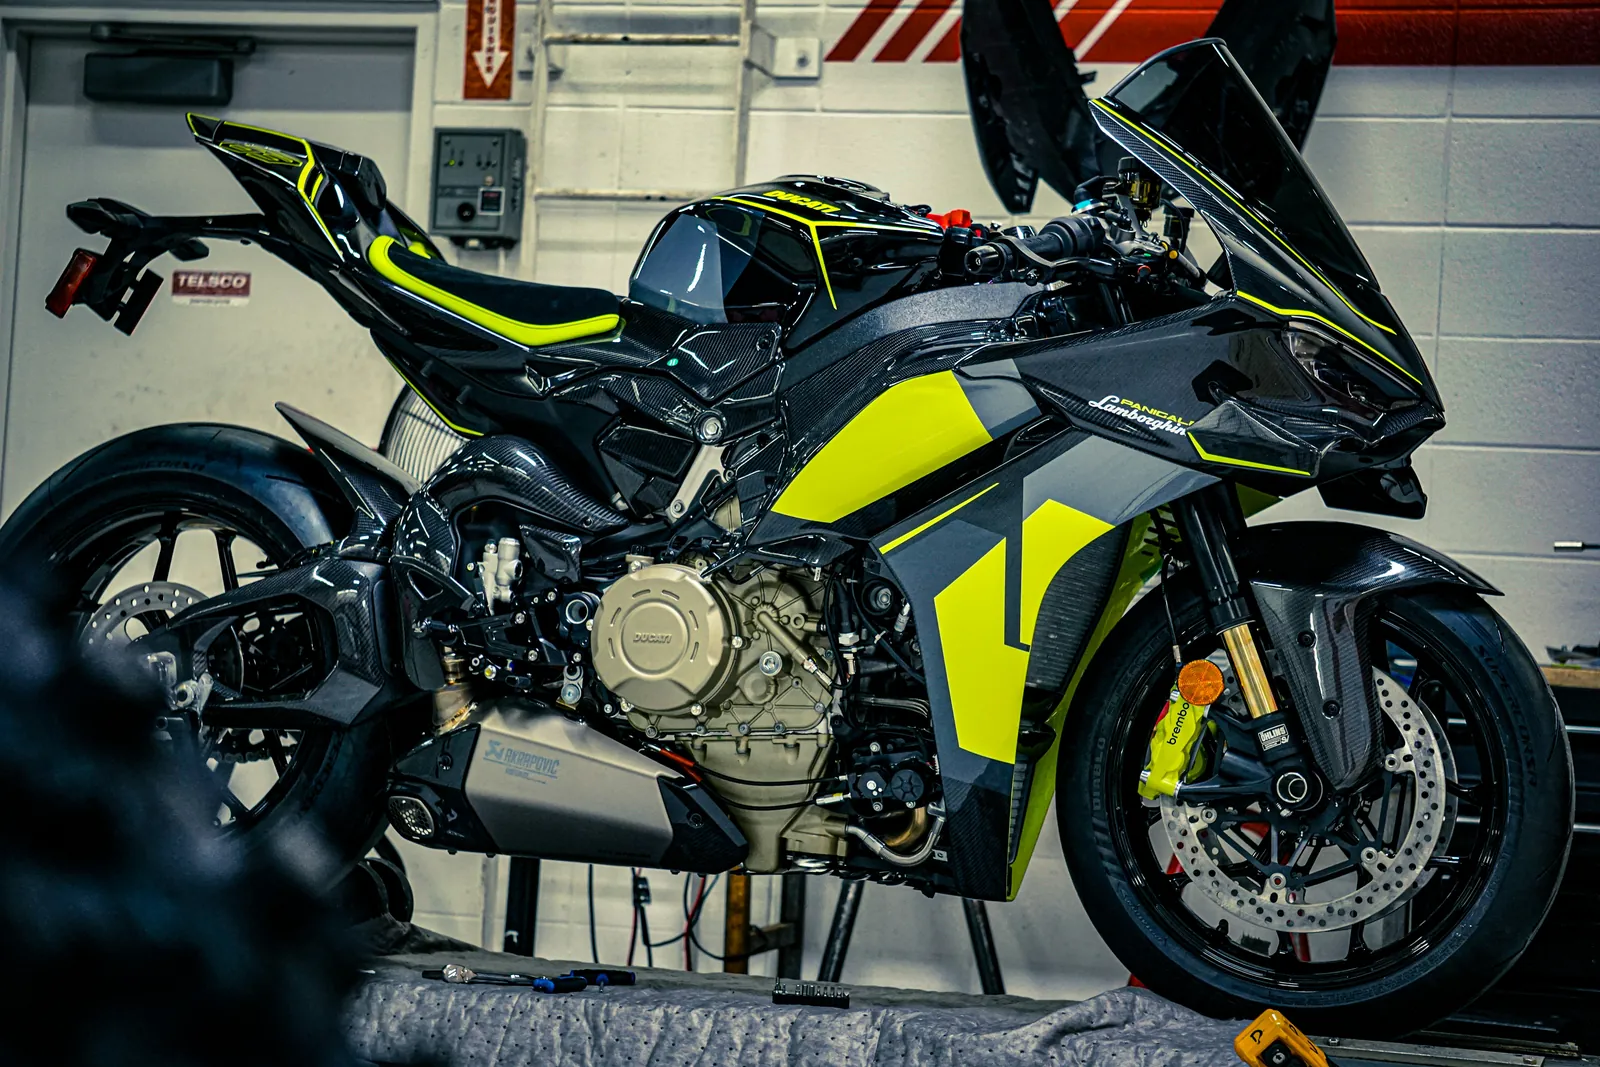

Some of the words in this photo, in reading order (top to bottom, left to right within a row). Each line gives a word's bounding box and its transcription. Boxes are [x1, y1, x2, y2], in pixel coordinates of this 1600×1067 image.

[762, 190, 841, 213] DUCATI
[1088, 395, 1188, 437] Lamborghin
[633, 632, 672, 644] DUCATI
[1167, 702, 1190, 745] brembo
